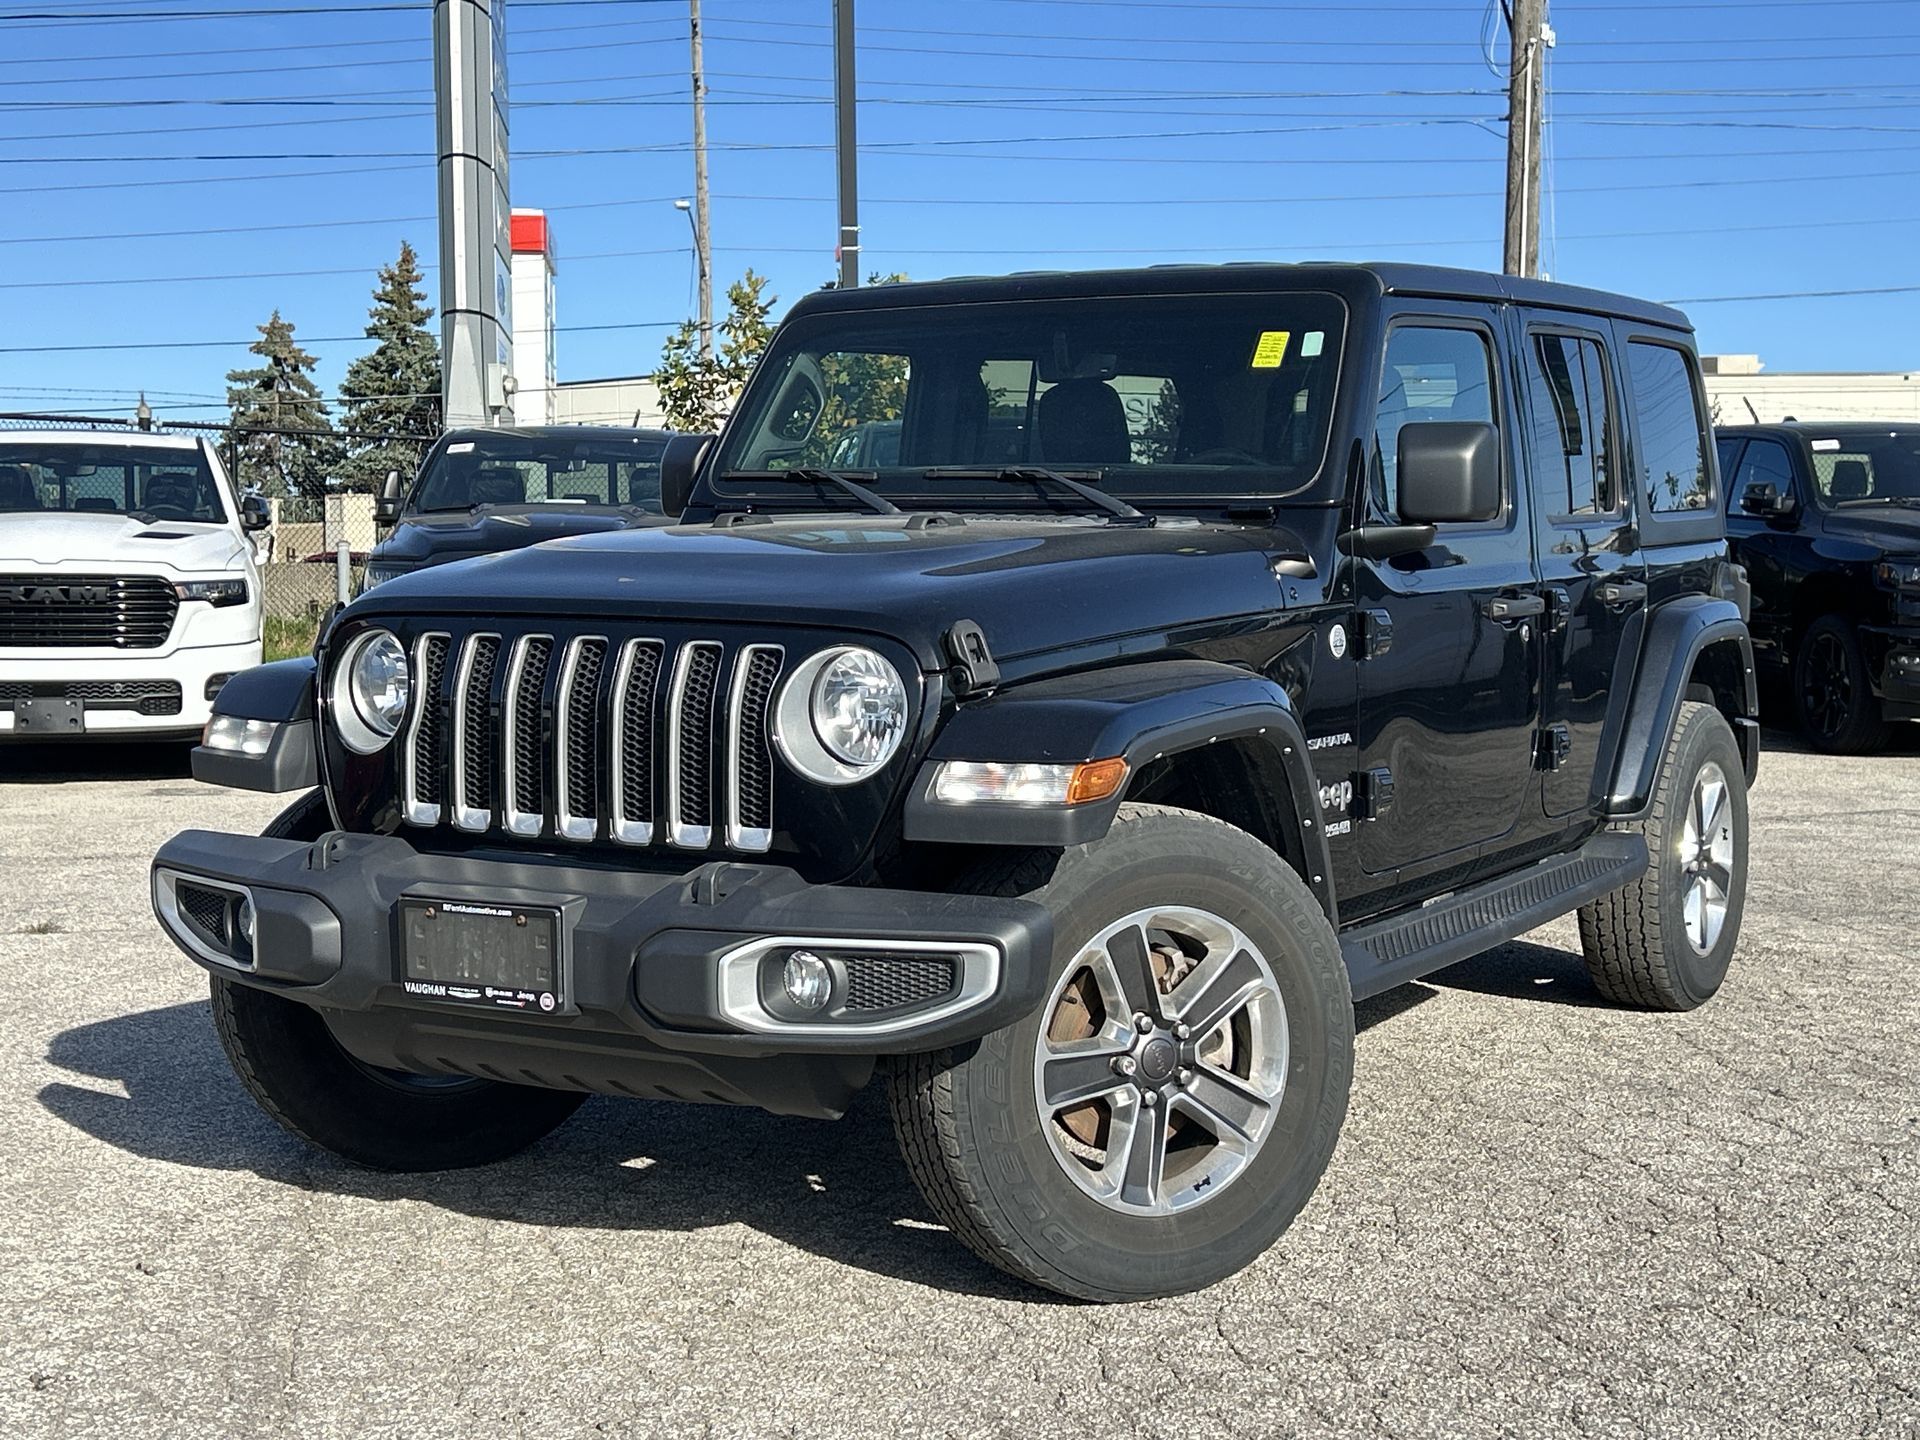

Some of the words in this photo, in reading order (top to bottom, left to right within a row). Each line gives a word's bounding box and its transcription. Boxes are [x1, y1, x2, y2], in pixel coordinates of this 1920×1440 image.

[0, 586, 109, 602] RAM
[1307, 732, 1352, 750] SAHARA
[404, 981, 446, 996] VAUGHAN
